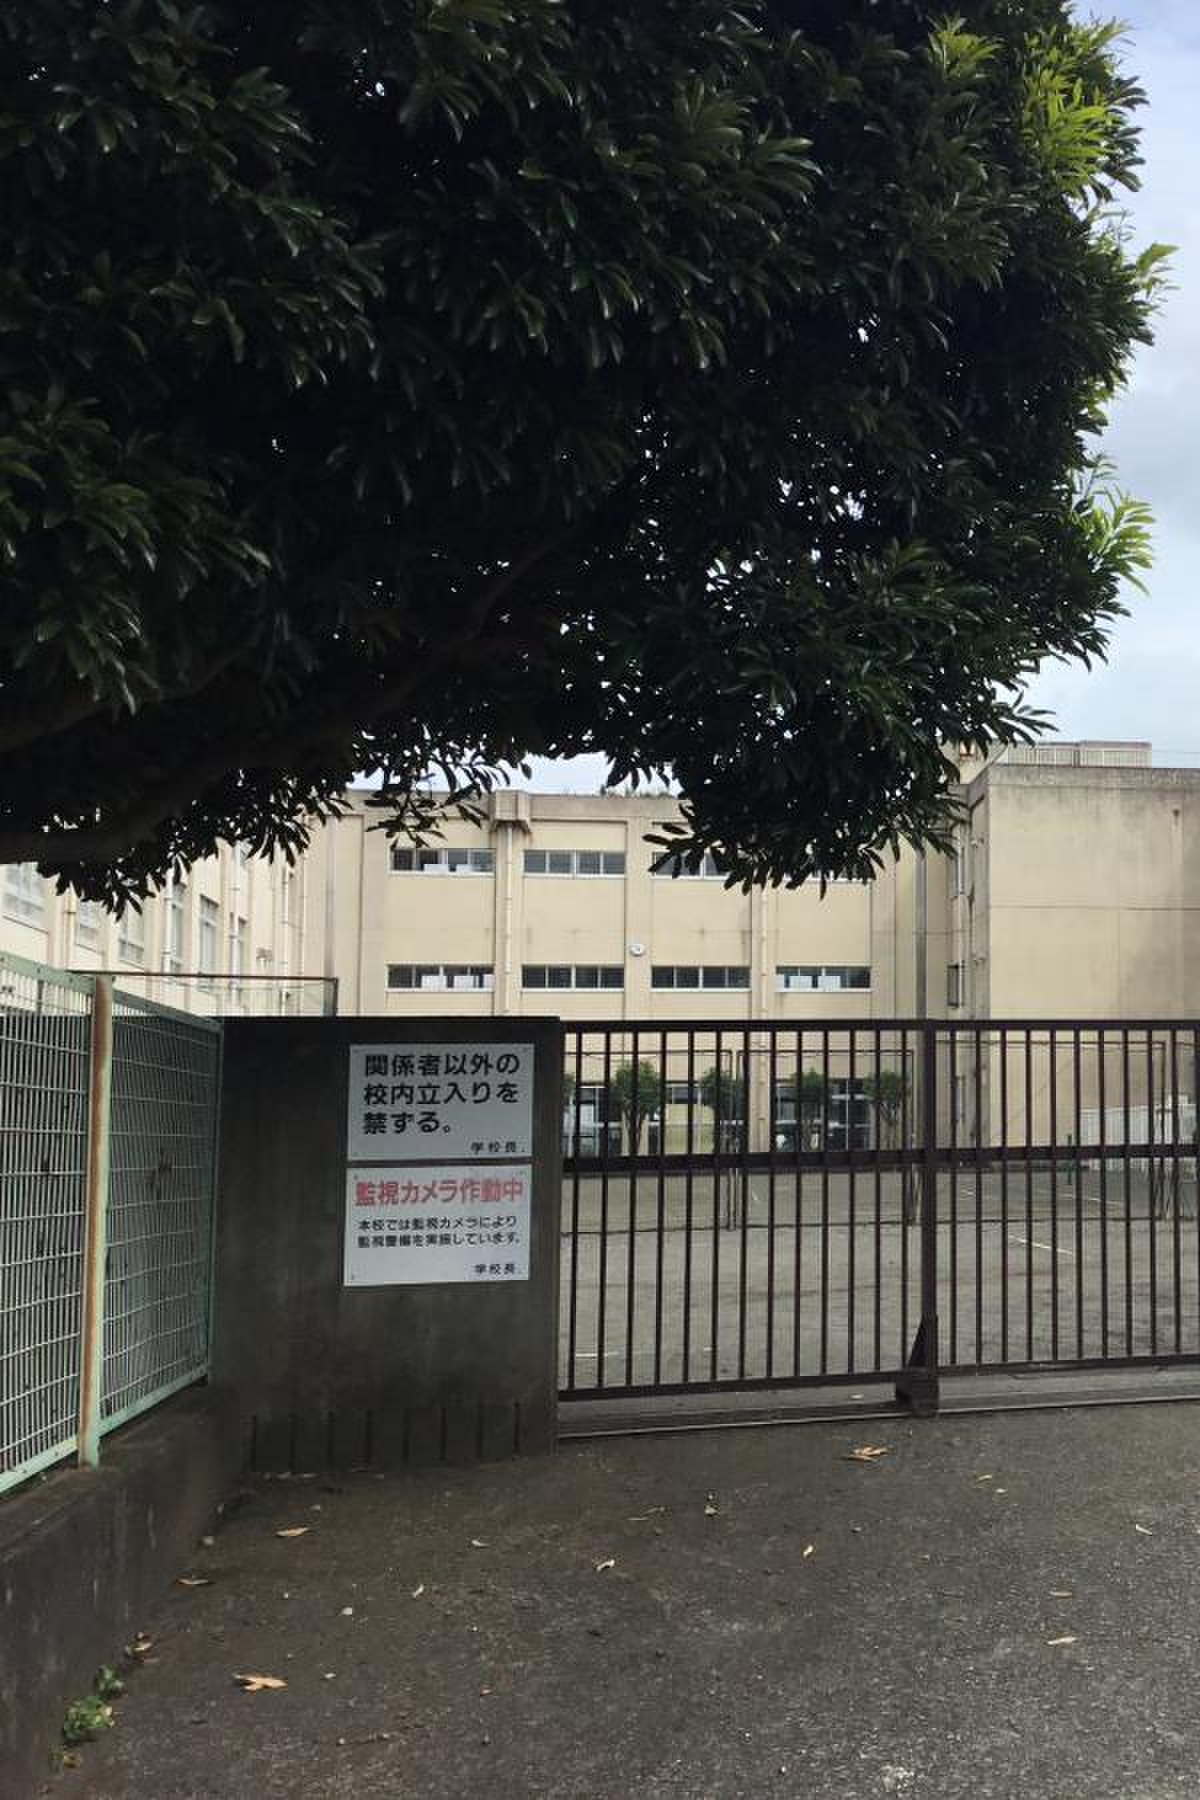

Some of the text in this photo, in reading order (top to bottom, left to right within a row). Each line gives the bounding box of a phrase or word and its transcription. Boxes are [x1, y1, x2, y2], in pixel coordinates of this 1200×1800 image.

[365, 1054, 520, 1077] 関係者以外の
[363, 1082, 518, 1105] 校内立入りを
[363, 1111, 451, 1135] 禁ずる。
[355, 1178, 523, 1207] 監視カメラ作動中
[358, 1215, 518, 1231] 本校では監視カメラにより
[474, 1263, 516, 1276] 学校長
